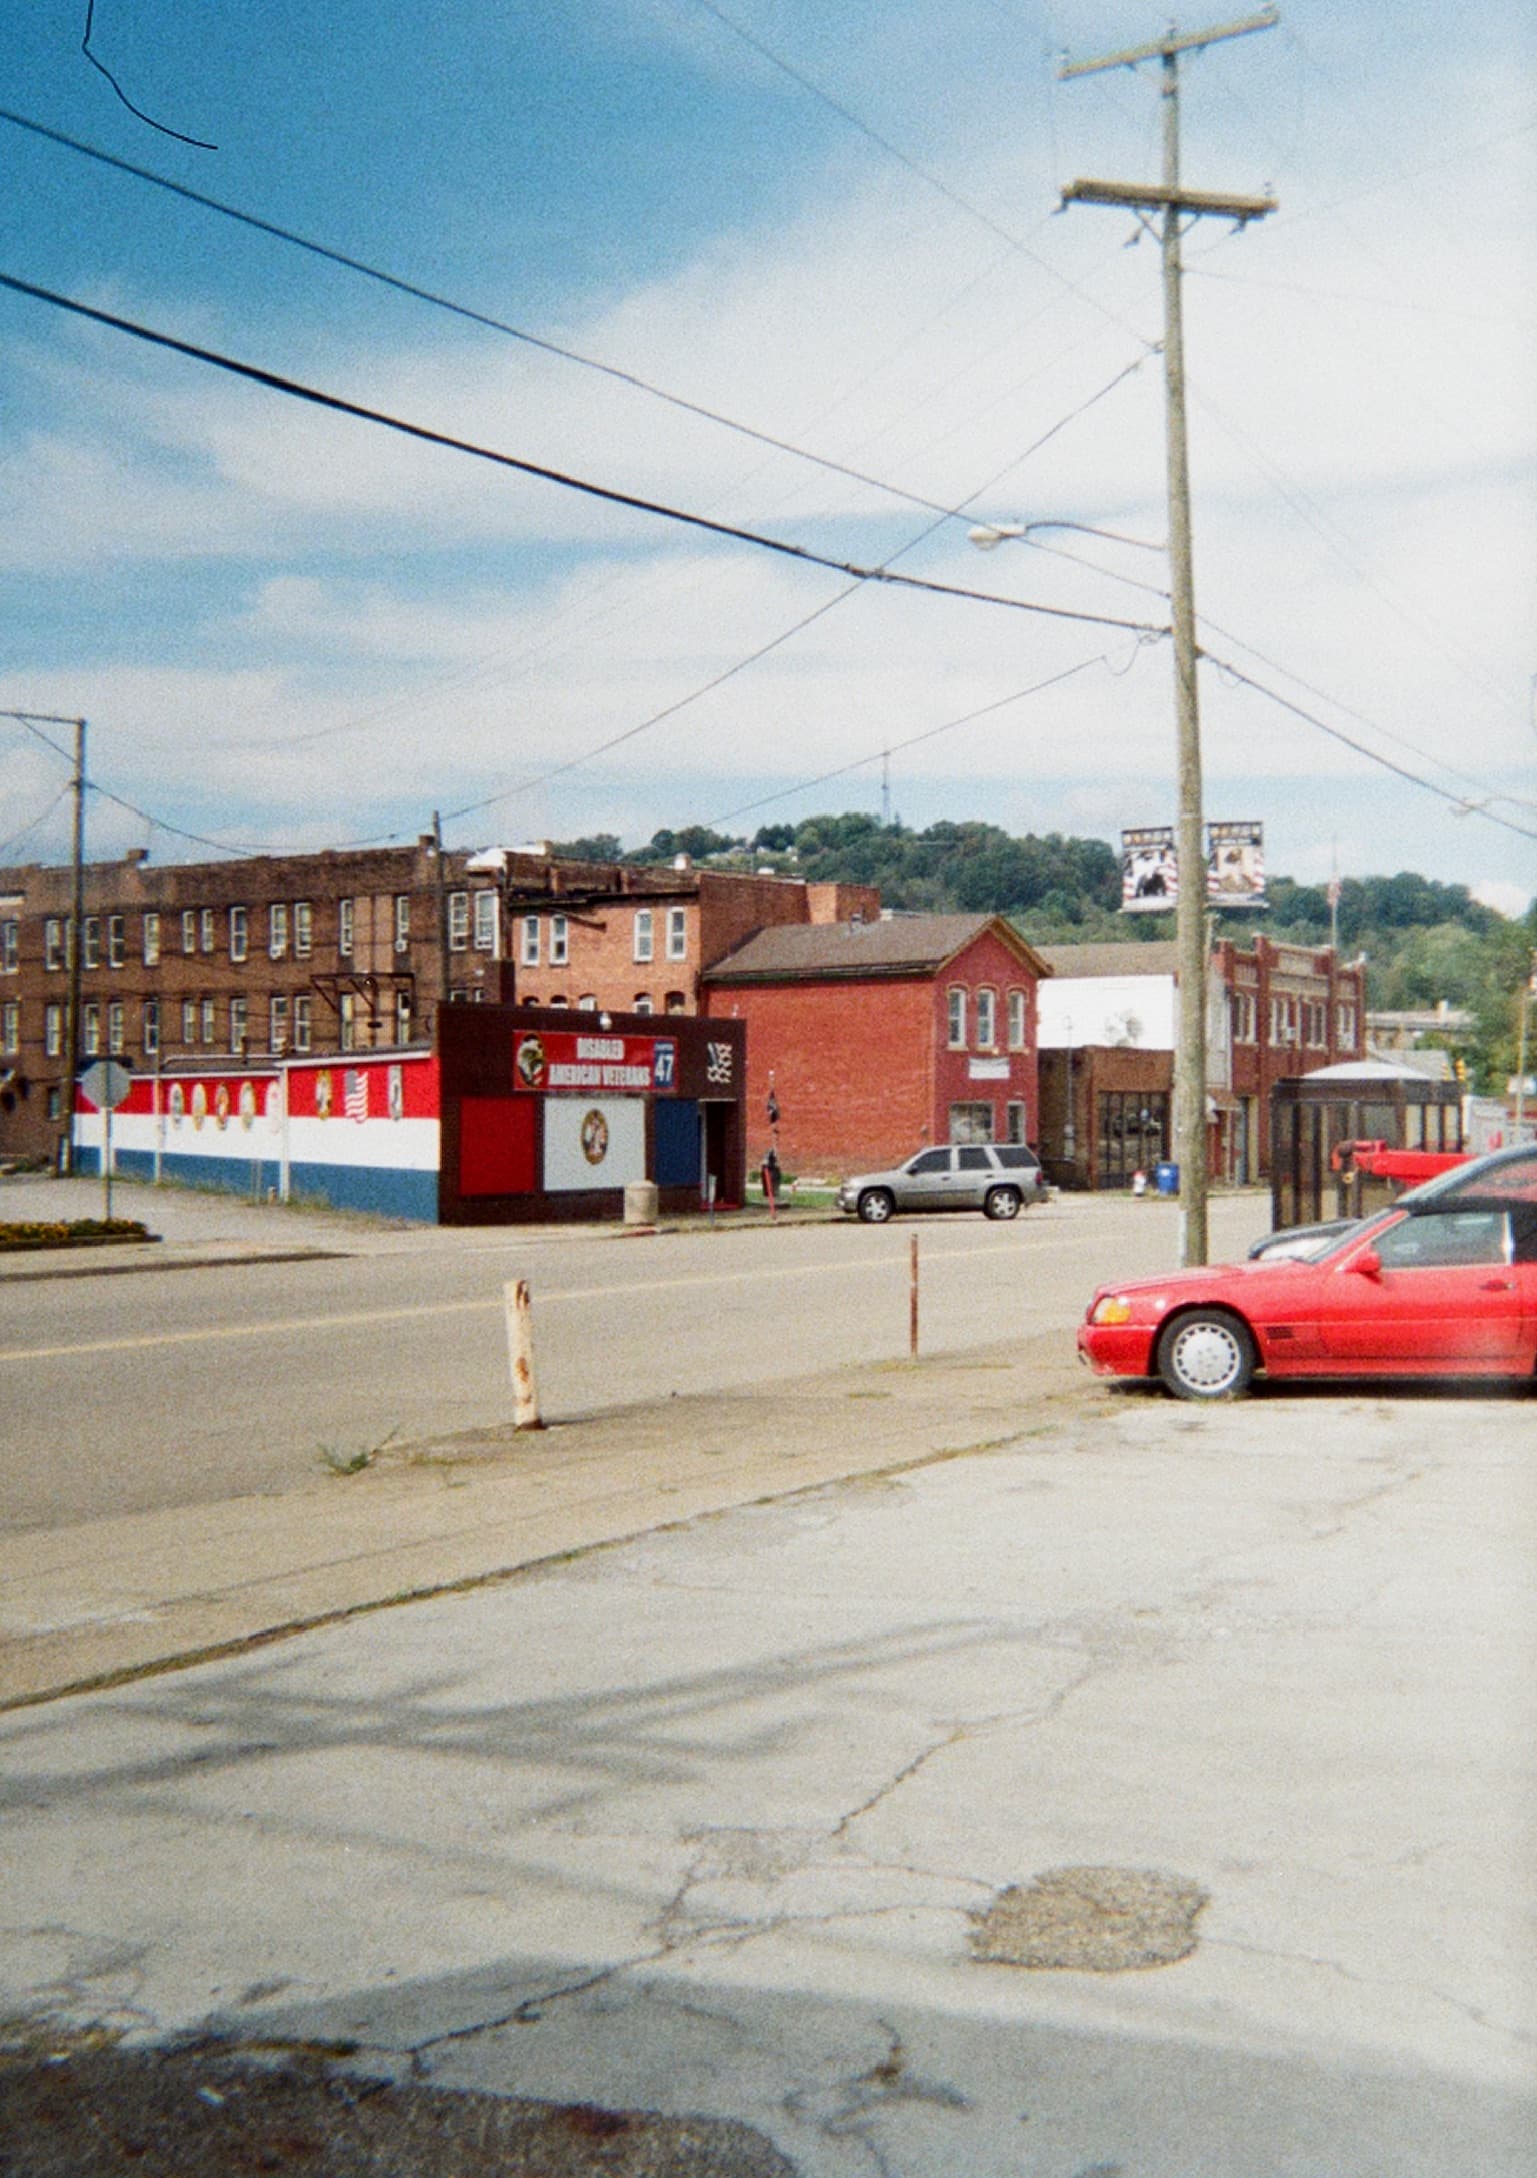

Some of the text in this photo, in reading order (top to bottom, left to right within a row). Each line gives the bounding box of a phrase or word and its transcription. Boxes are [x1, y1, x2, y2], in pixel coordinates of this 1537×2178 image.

[549, 1064, 650, 1086] AMERICAN VETERANS
[654, 1053, 675, 1082] 47
